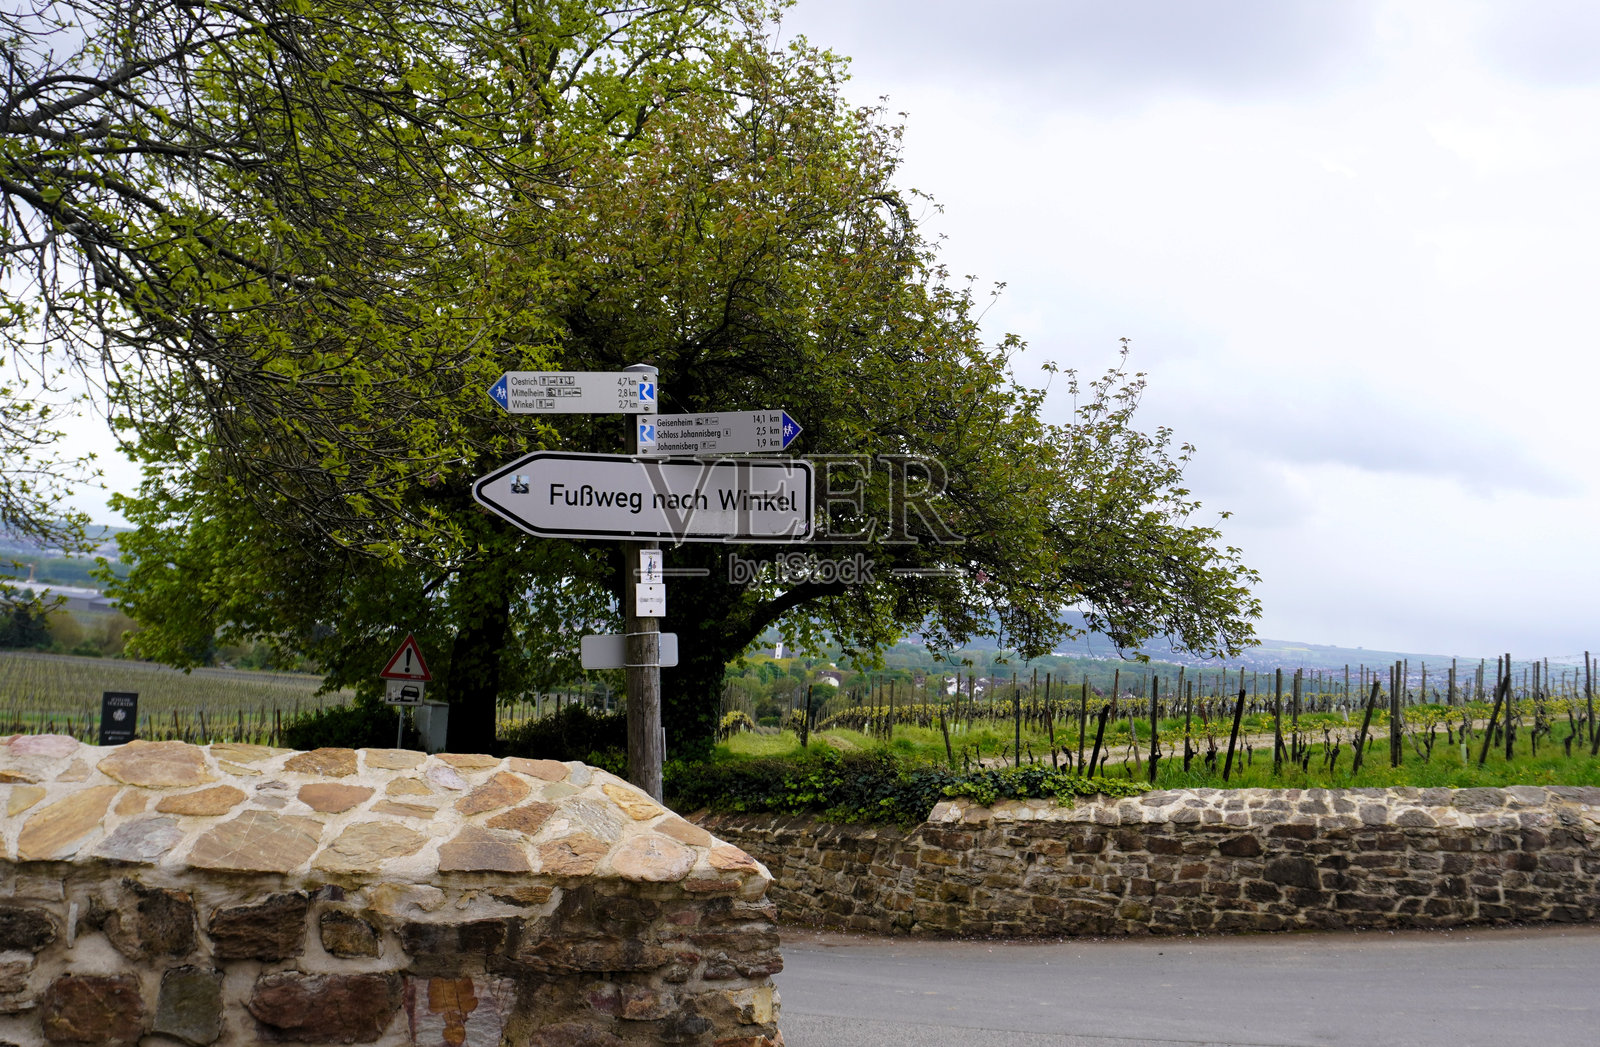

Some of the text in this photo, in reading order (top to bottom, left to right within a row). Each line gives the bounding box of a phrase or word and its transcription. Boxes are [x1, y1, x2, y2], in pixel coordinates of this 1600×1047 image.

[511, 376, 637, 387] Oestrich 4,7 km
[511, 388, 637, 398] Mittelheim 2,8 km
[511, 400, 535, 409] Winkel
[618, 400, 628, 409] 2,7
[629, 401, 638, 409] km
[656, 414, 780, 427] Geisenheim 14,1 km
[656, 426, 780, 439] Schloss Johannisberg 2,5 km
[656, 438, 780, 451] Johannisberg 1,9 km
[549, 483, 798, 514] Fußweg nach Winkel
